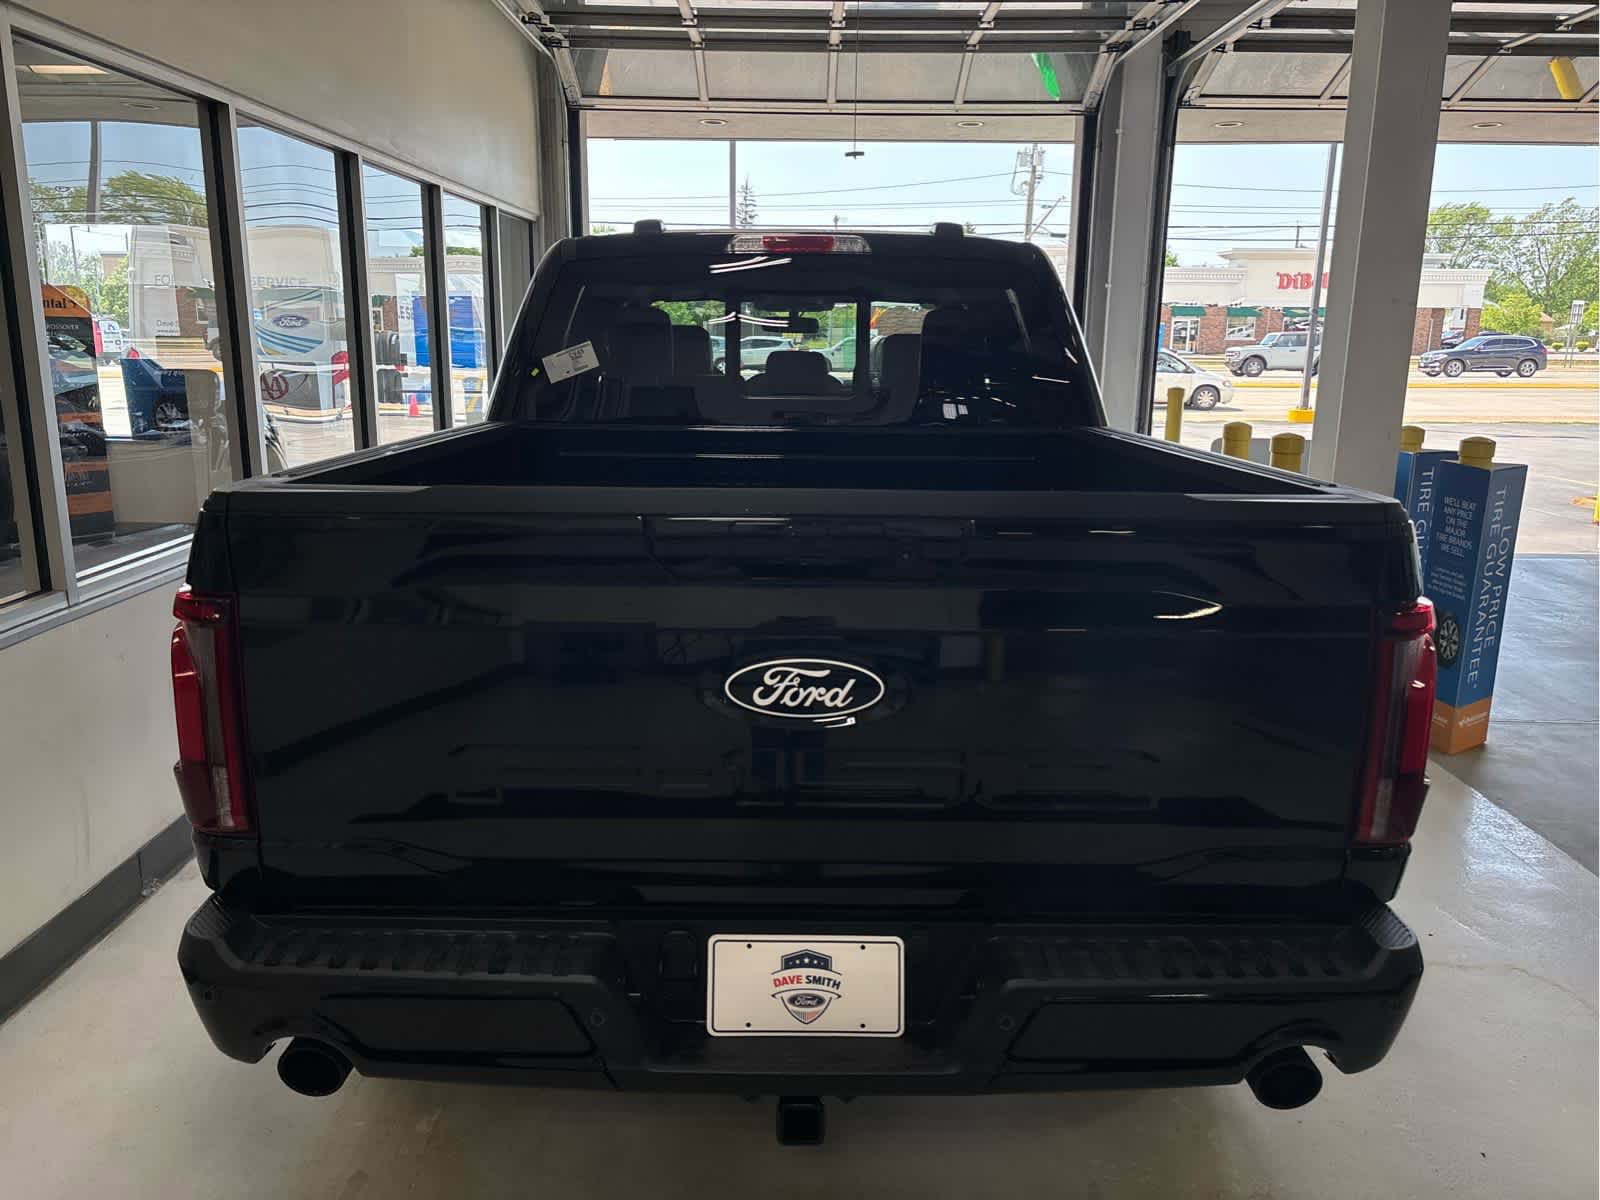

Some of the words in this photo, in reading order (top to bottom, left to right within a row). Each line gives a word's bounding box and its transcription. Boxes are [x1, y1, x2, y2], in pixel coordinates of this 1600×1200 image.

[279, 315, 304, 328] Ford
[1416, 466, 1435, 513] TIRE
[1488, 485, 1507, 537] TIRE
[1445, 525, 1467, 538] MAJOR
[1495, 525, 1513, 577] LOW
[1483, 584, 1503, 649] PRICE
[752, 666, 857, 708] Ford
[772, 974, 804, 988] DAVE
[804, 974, 842, 991] SMITH
